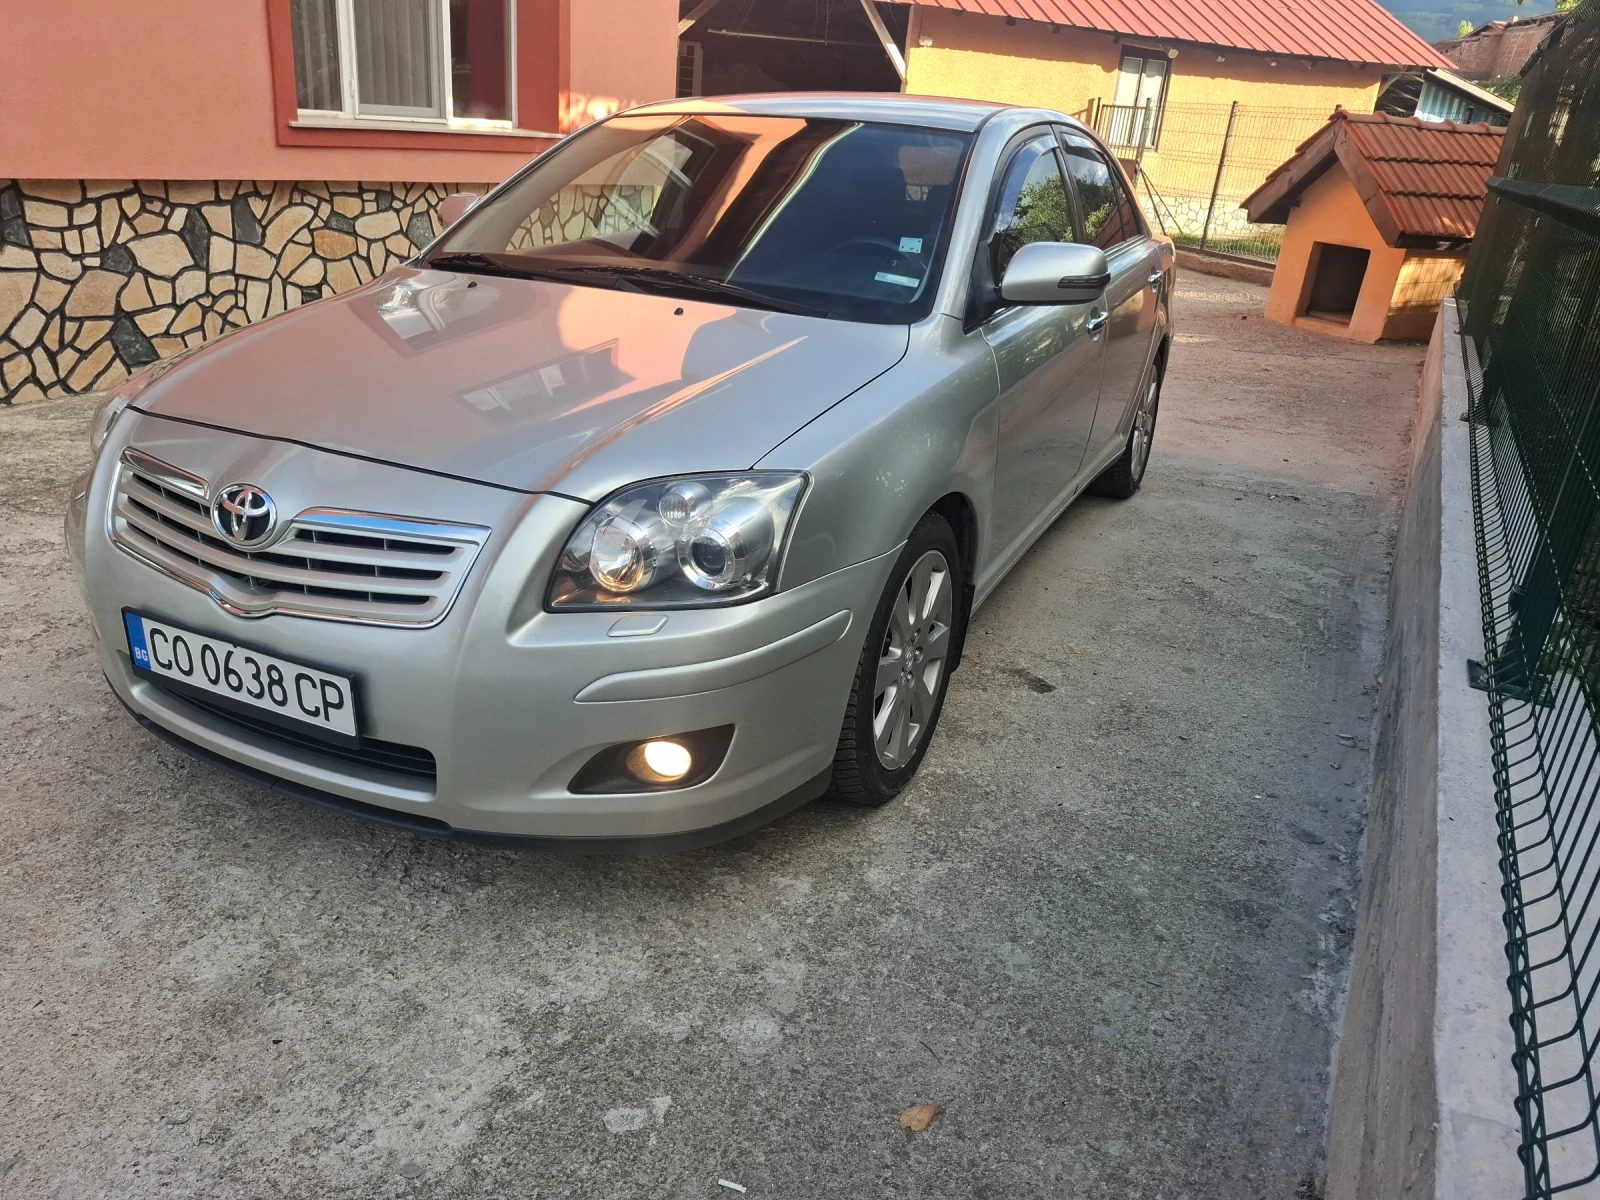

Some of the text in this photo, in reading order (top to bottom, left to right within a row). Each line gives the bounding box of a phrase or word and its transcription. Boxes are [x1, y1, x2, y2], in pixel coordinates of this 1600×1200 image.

[134, 647, 149, 662] BG
[149, 627, 344, 722] CO 0638 CP
